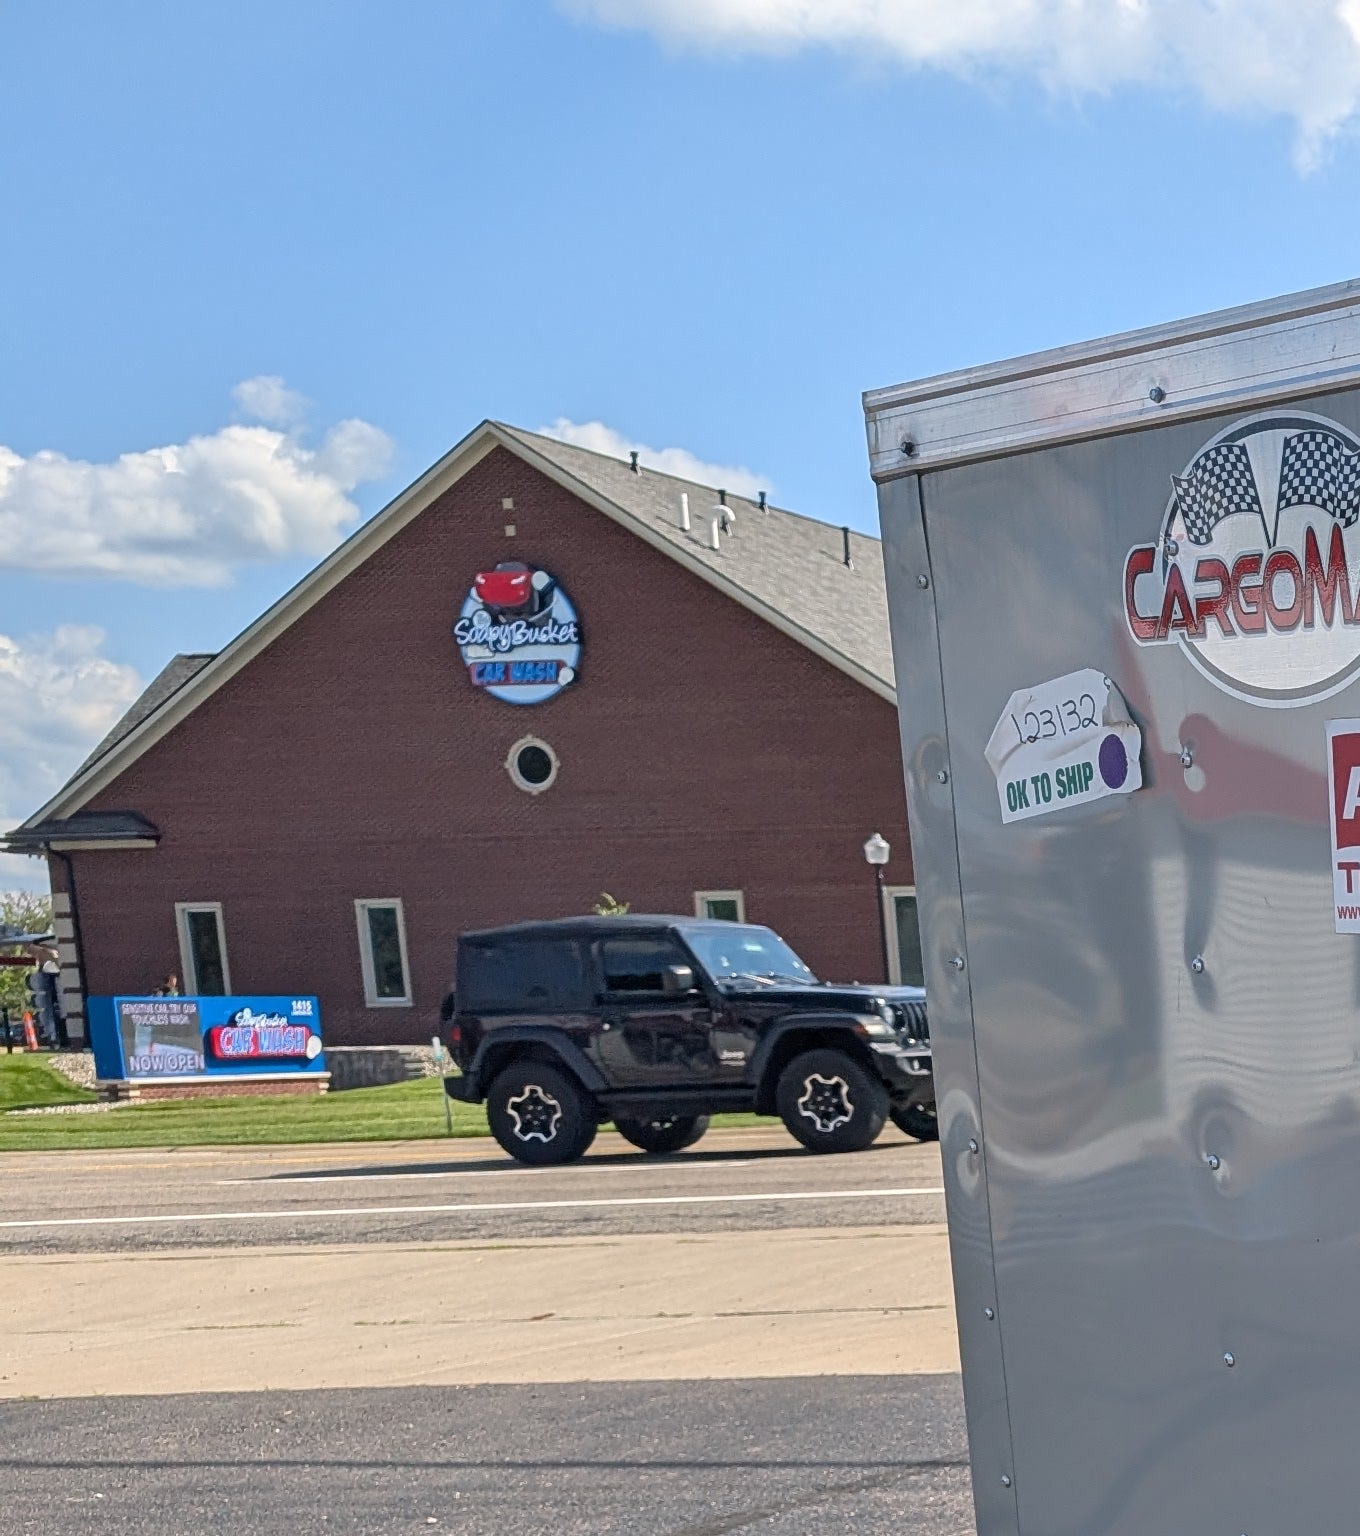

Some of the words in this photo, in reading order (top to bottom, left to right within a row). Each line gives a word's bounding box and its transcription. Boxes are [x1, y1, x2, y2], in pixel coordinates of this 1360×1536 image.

[476, 662, 506, 681] CAR
[510, 662, 557, 681] WASH
[1011, 694, 1098, 744] 123132
[1006, 779, 1030, 812] OK
[1031, 772, 1051, 805] TO
[1056, 761, 1093, 799] SHIP
[129, 1056, 164, 1071] NOW
[168, 1054, 205, 1070] OPEN
